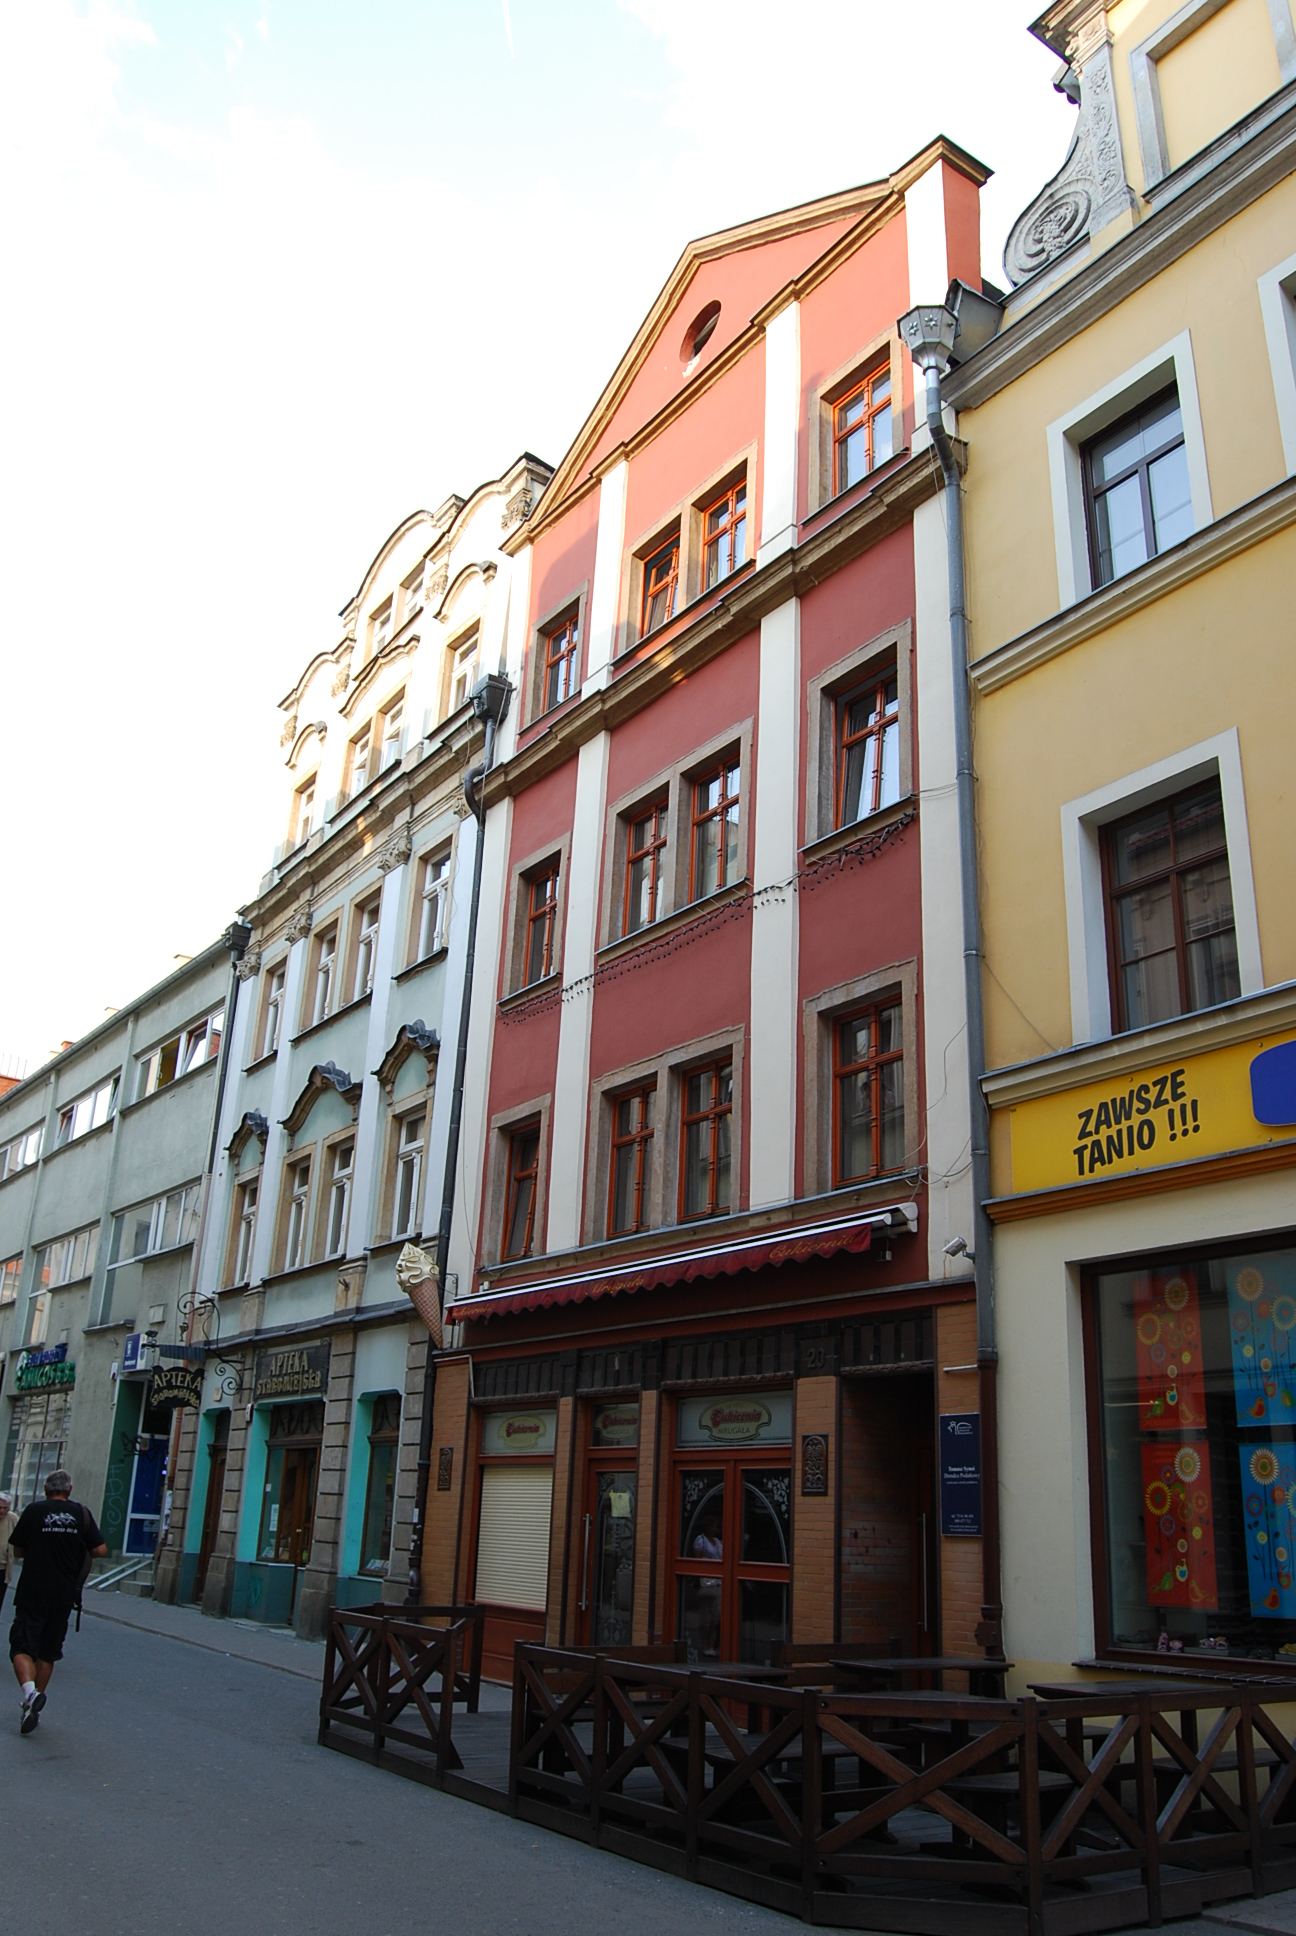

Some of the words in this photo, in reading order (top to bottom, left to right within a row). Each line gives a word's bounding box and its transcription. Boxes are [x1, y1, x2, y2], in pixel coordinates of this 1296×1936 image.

[1077, 1068, 1187, 1141] ZAWSZE
[1073, 1118, 1156, 1176] TANIO
[1167, 1099, 1201, 1142] !!!
[271, 1350, 309, 1376] APTEKA
[807, 1347, 825, 1369] 20
[154, 1371, 203, 1391] APTEKA
